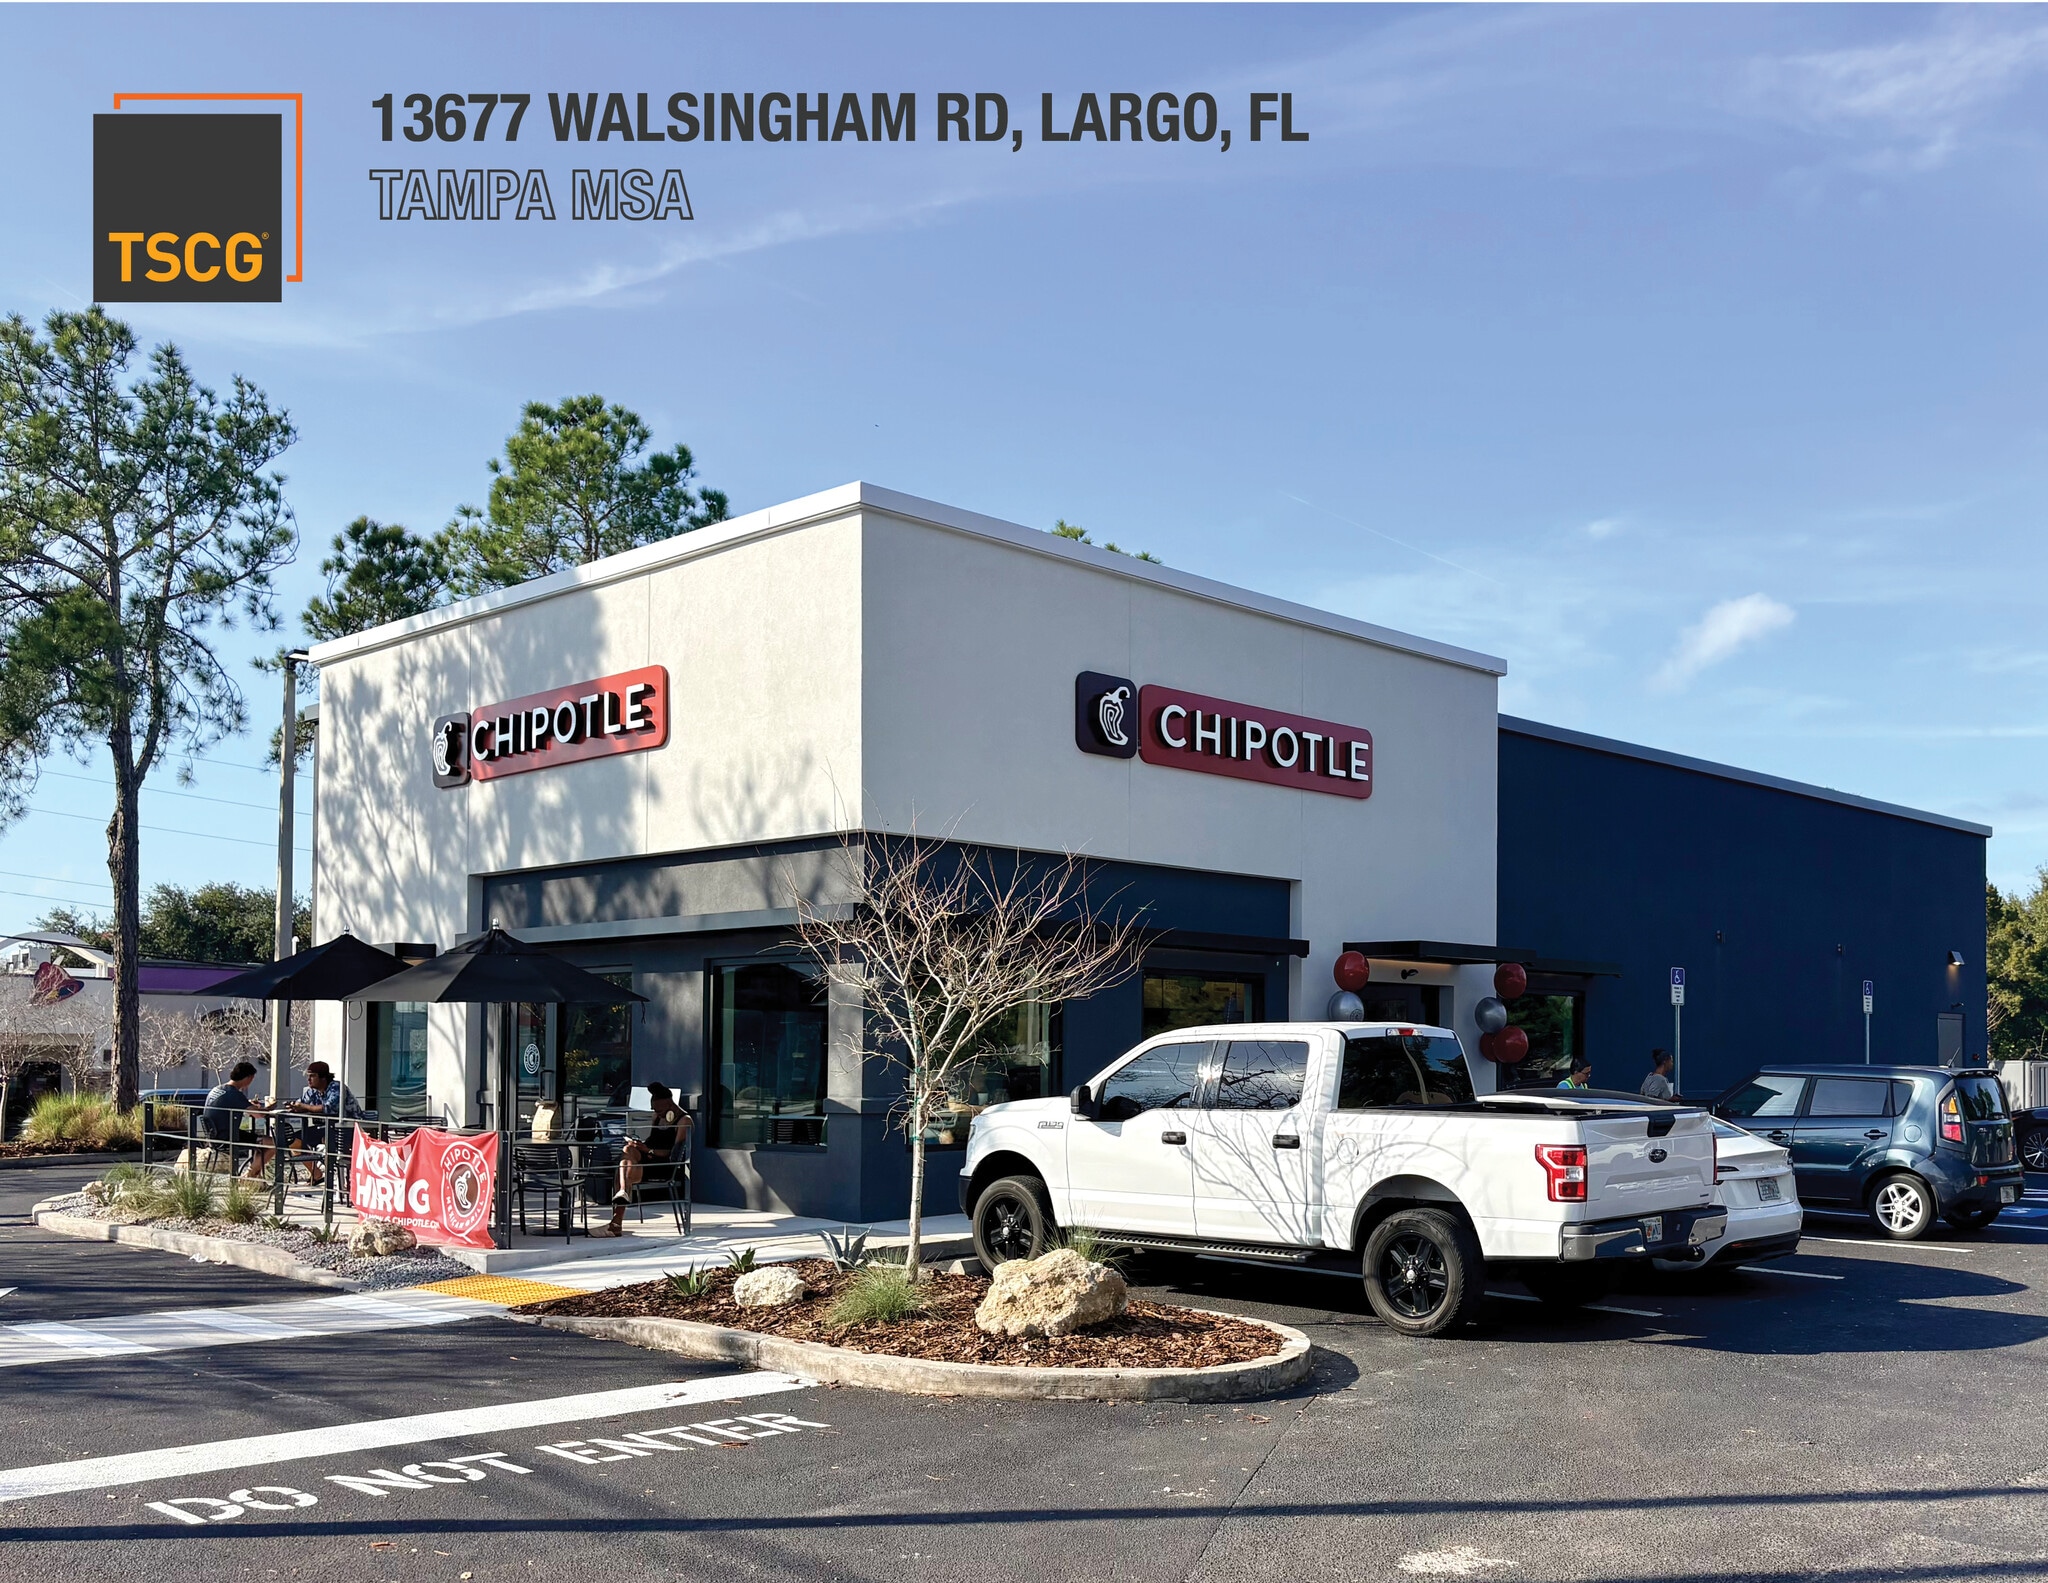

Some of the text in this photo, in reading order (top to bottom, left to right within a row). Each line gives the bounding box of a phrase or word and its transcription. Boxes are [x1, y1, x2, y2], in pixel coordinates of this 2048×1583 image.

[471, 682, 652, 762] CHIPOTLE
[1159, 703, 1370, 782] CHIPOTLE
[355, 1137, 413, 1177] NOW
[144, 1412, 832, 1525] DO NOT ENTER
